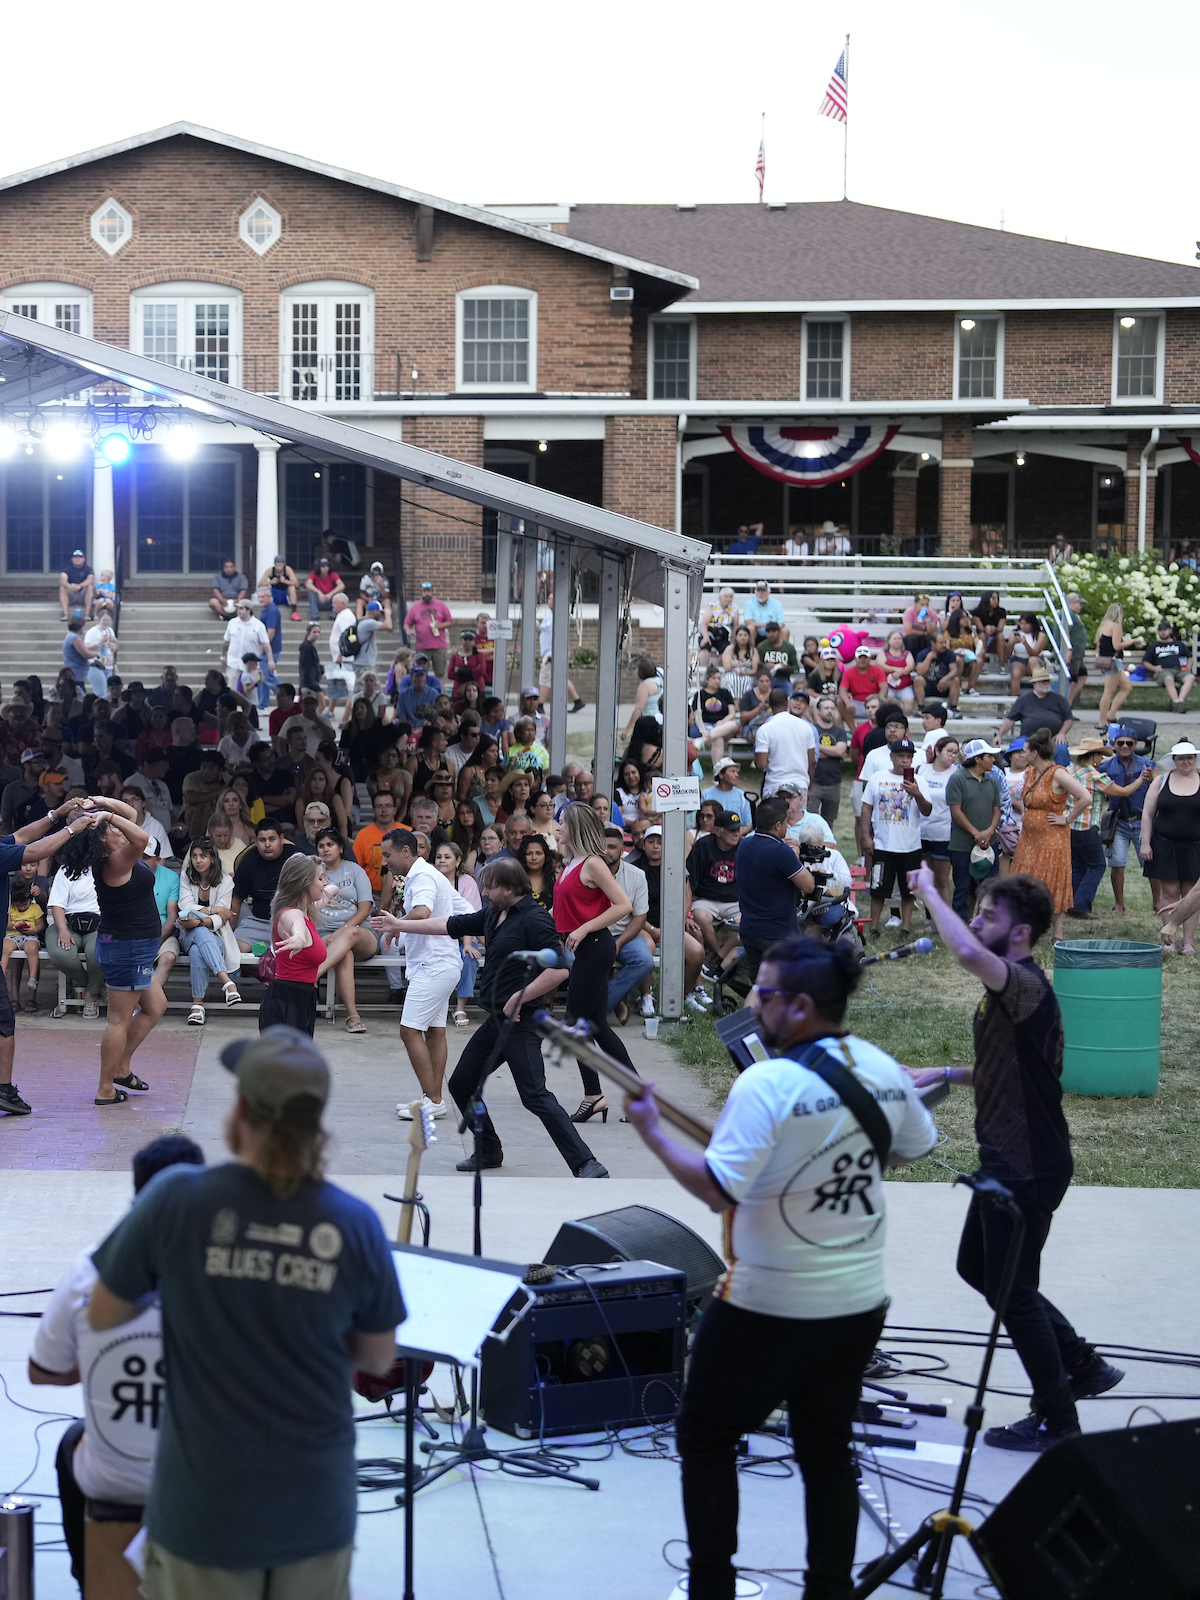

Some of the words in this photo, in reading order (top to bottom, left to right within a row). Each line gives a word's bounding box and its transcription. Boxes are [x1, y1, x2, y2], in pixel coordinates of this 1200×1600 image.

[764, 651, 788, 664] AERO
[792, 1102, 812, 1117] EL
[205, 1246, 274, 1281] BLUES
[275, 1253, 338, 1293] CREW
